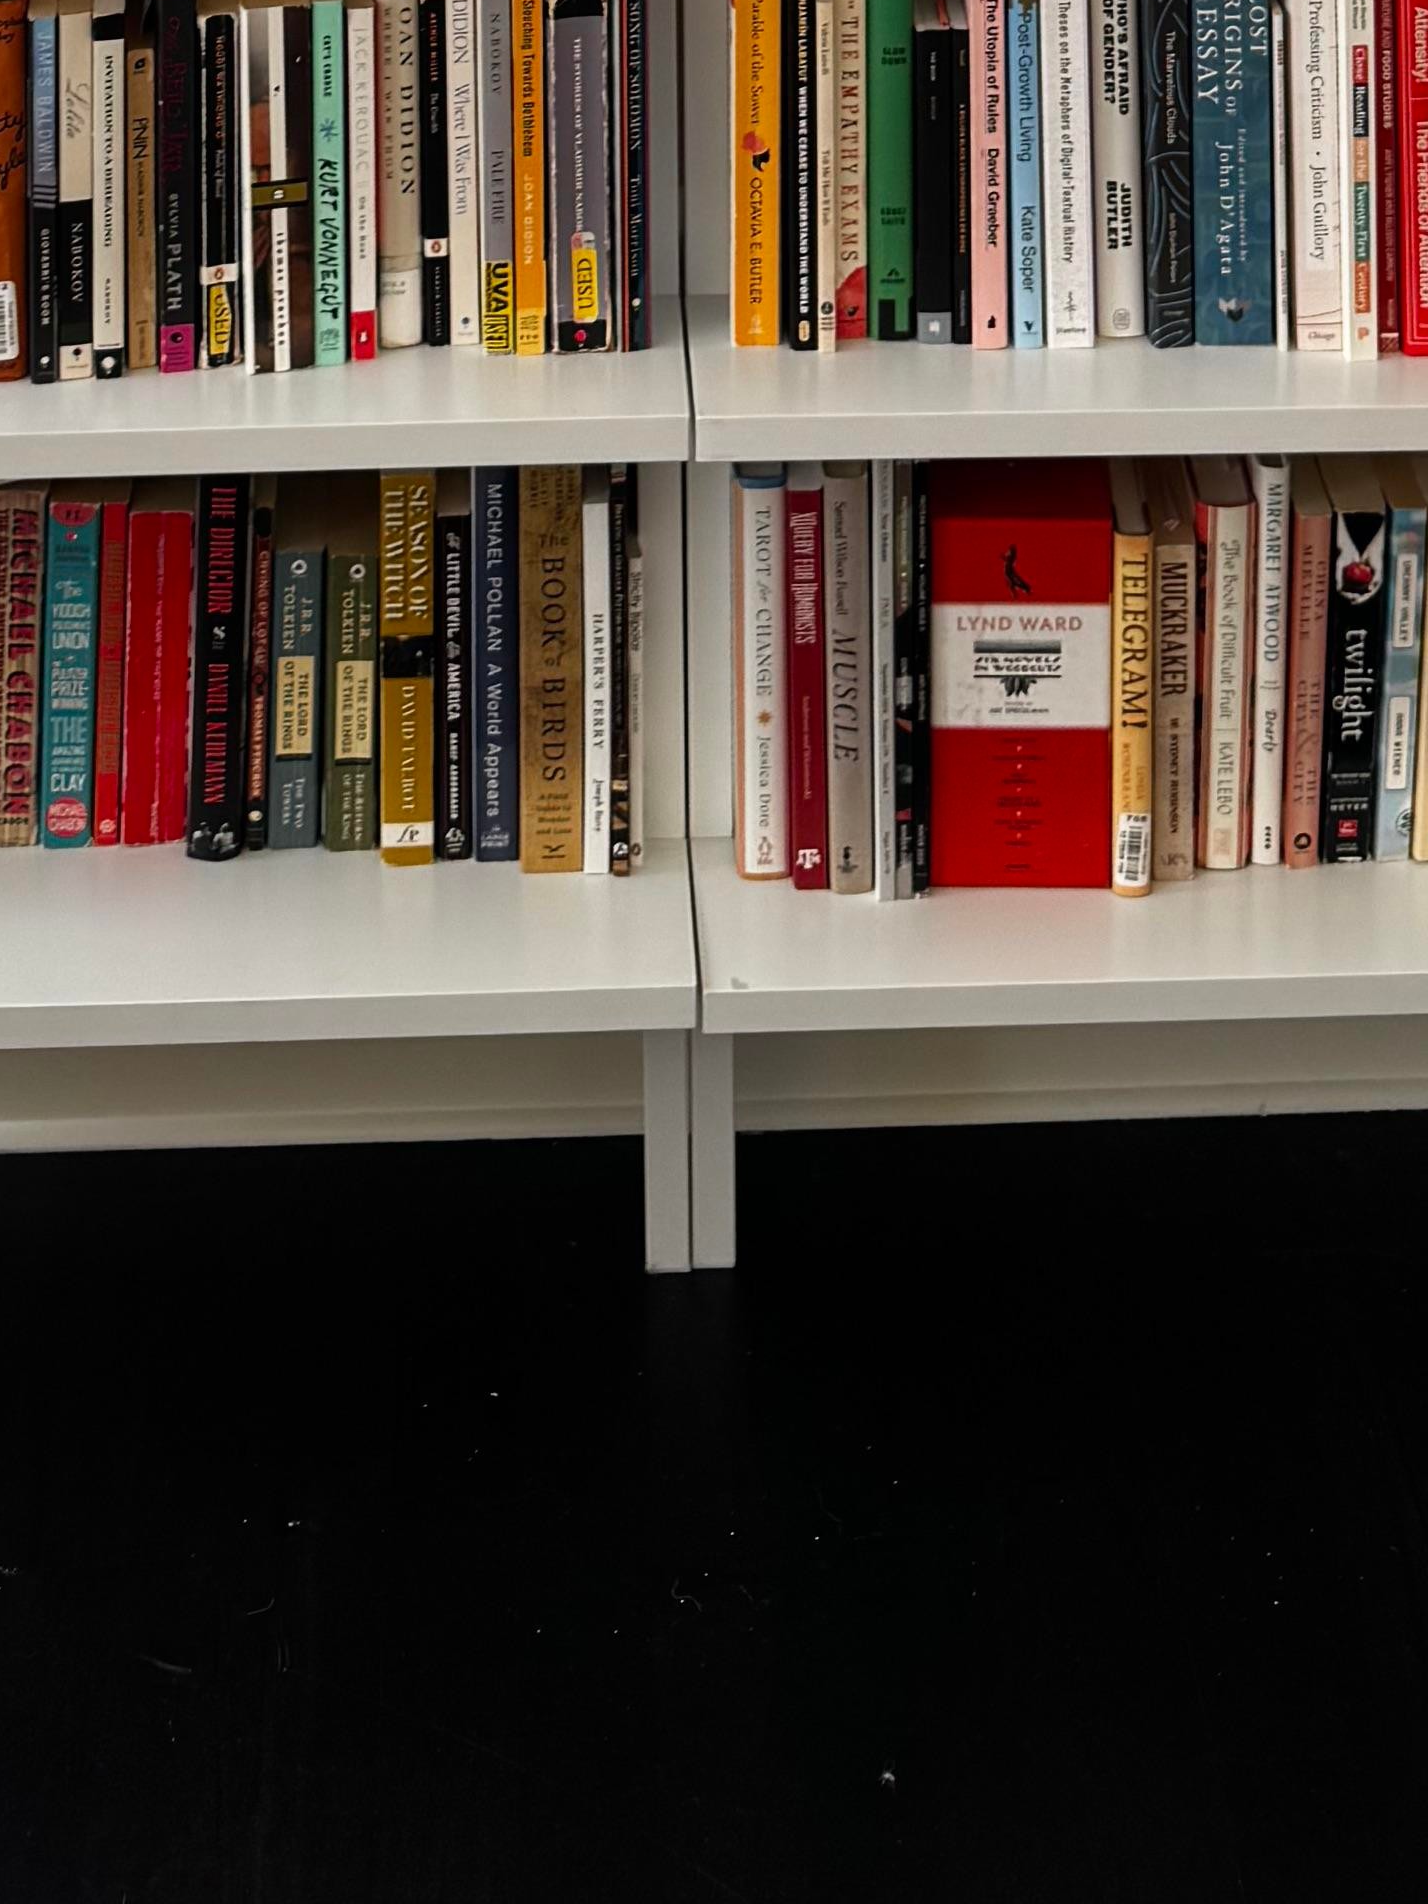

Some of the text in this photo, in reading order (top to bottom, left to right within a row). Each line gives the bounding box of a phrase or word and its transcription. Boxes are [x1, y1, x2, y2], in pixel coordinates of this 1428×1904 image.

[1107, 181, 1117, 250] BUTLER
[1120, 183, 1132, 247] JUDITH
[576, 258, 592, 311] USED
[486, 484, 504, 818] MICHAEL POLLAN A World Appears
[957, 617, 1083, 632] LYND WARD
[1121, 552, 1148, 730] TELEGRAM!
[1161, 561, 1187, 696] MUCKRAKER
[1332, 629, 1373, 743] twilight
